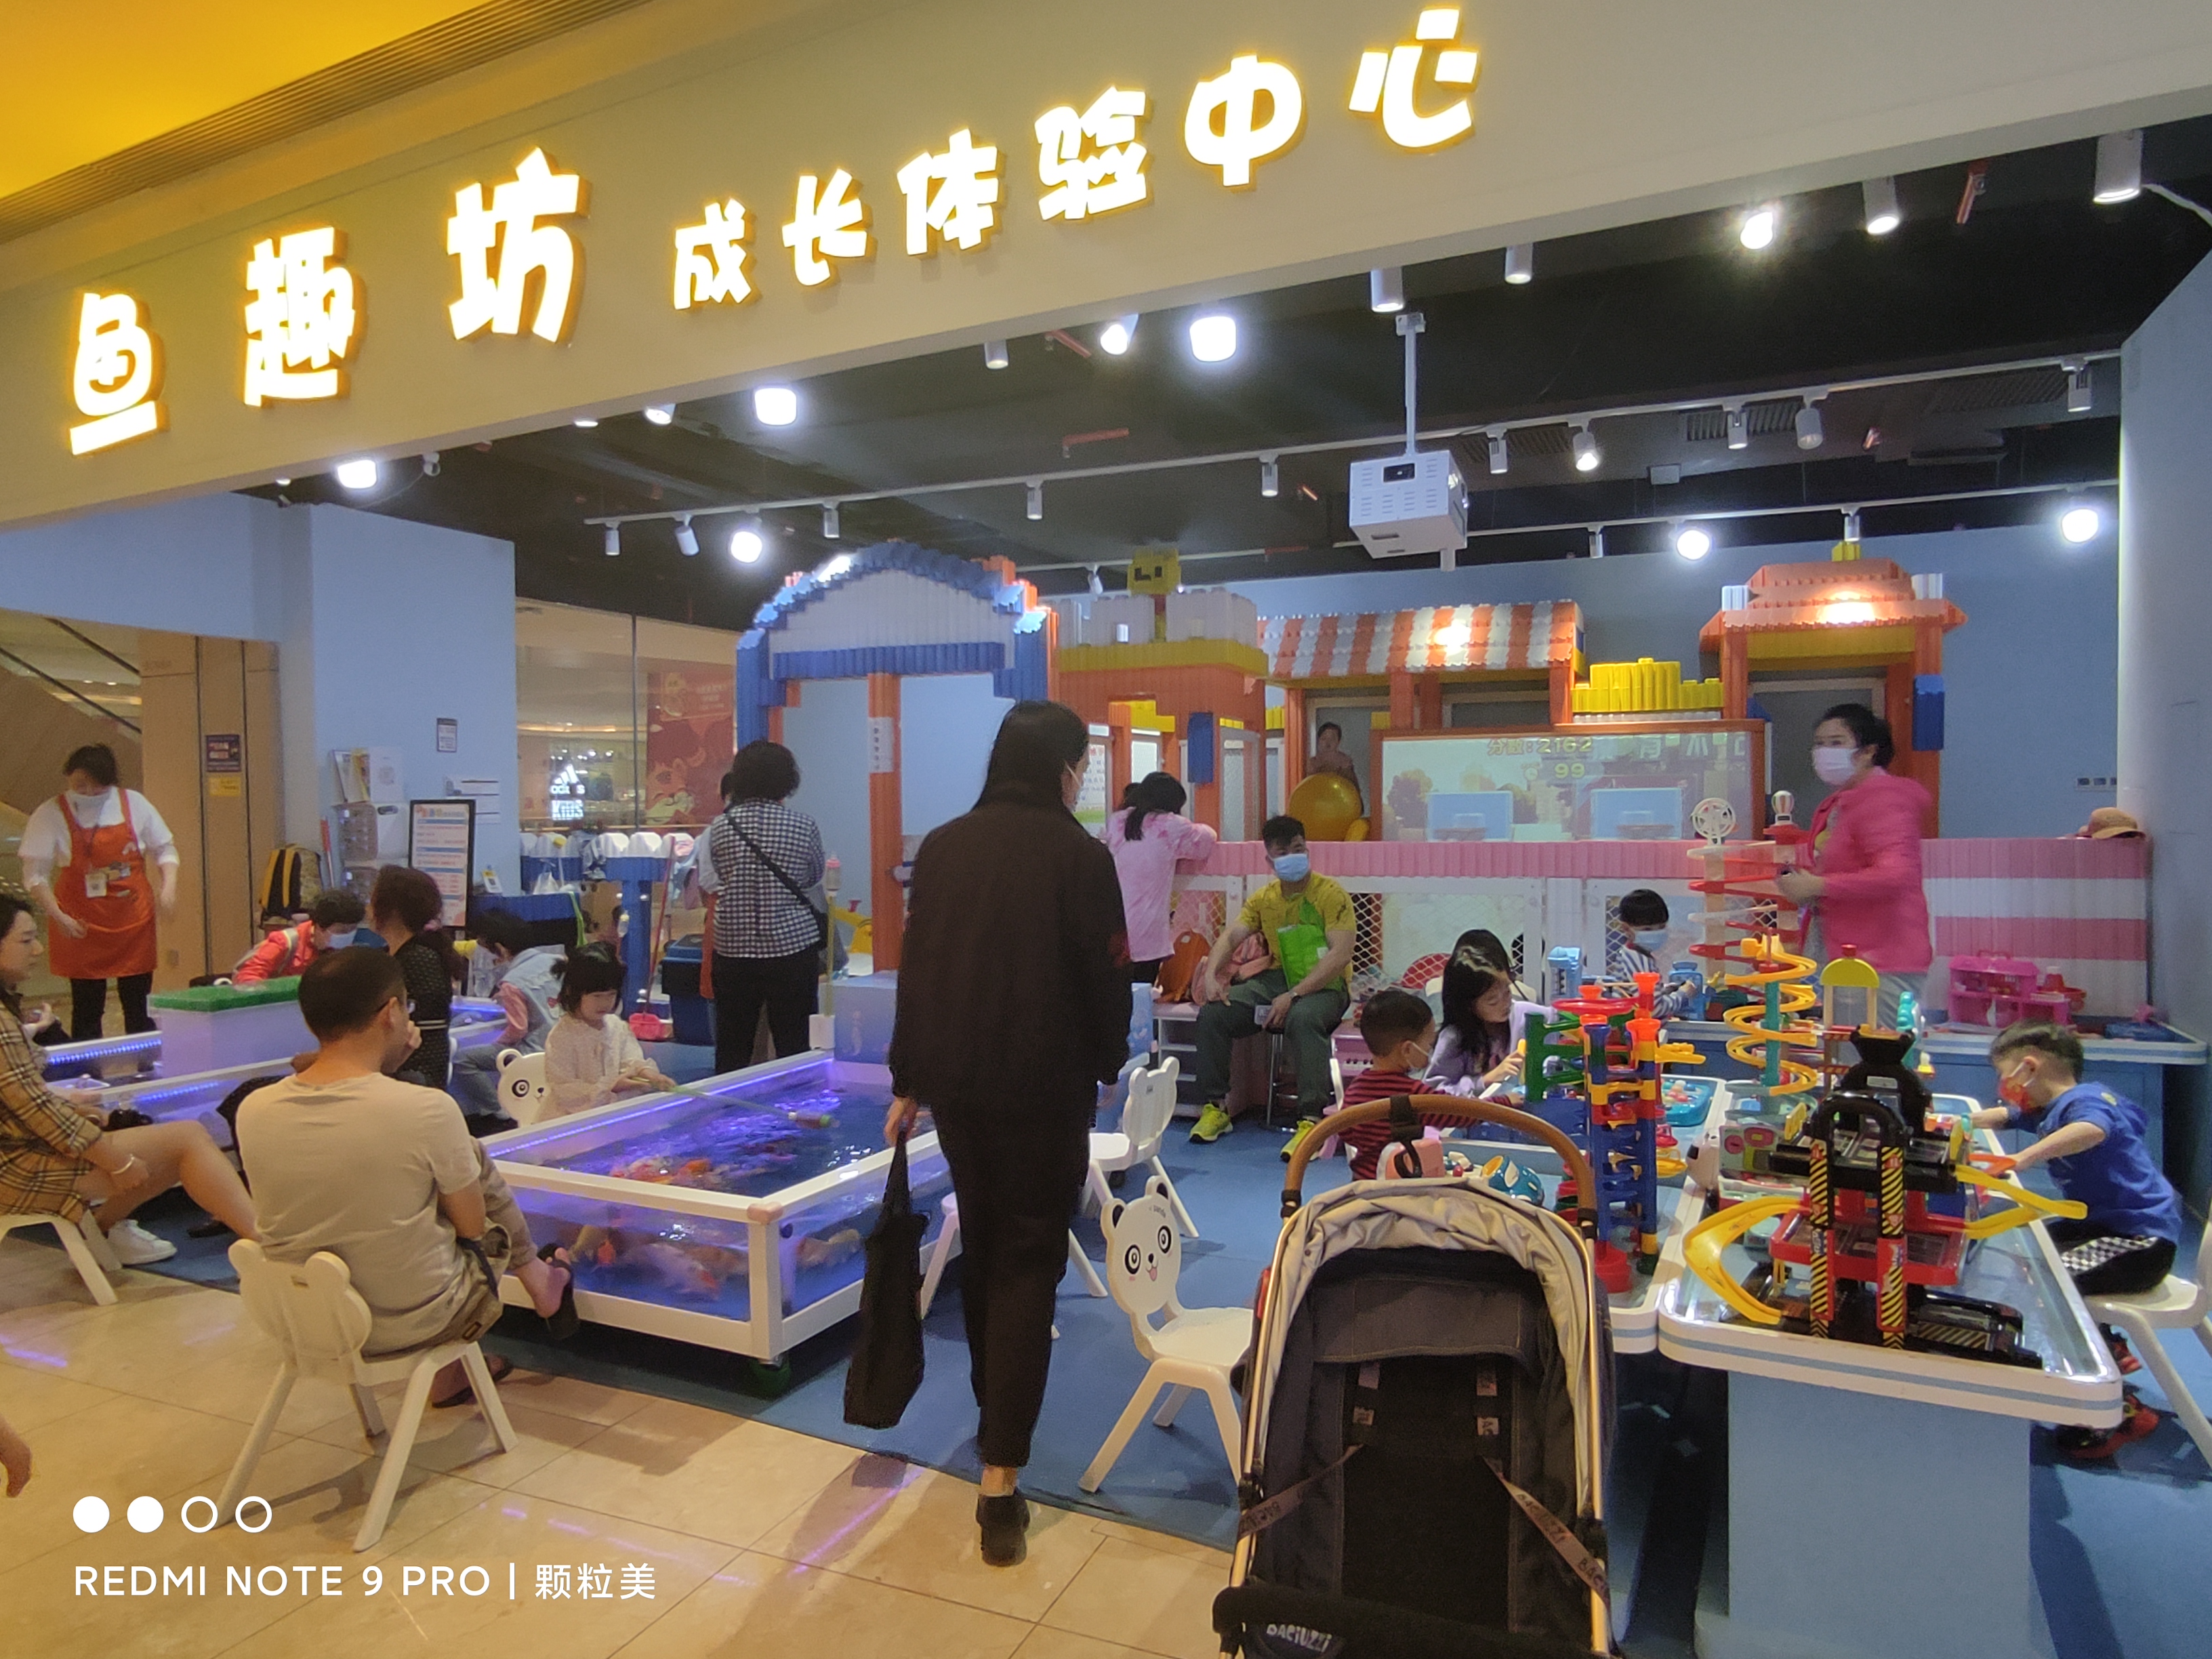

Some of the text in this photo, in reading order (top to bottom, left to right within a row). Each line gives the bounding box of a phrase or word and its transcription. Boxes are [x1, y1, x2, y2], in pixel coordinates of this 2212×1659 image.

[674, 8, 1477, 309] 成长体验中心
[1554, 763, 1585, 779] 99
